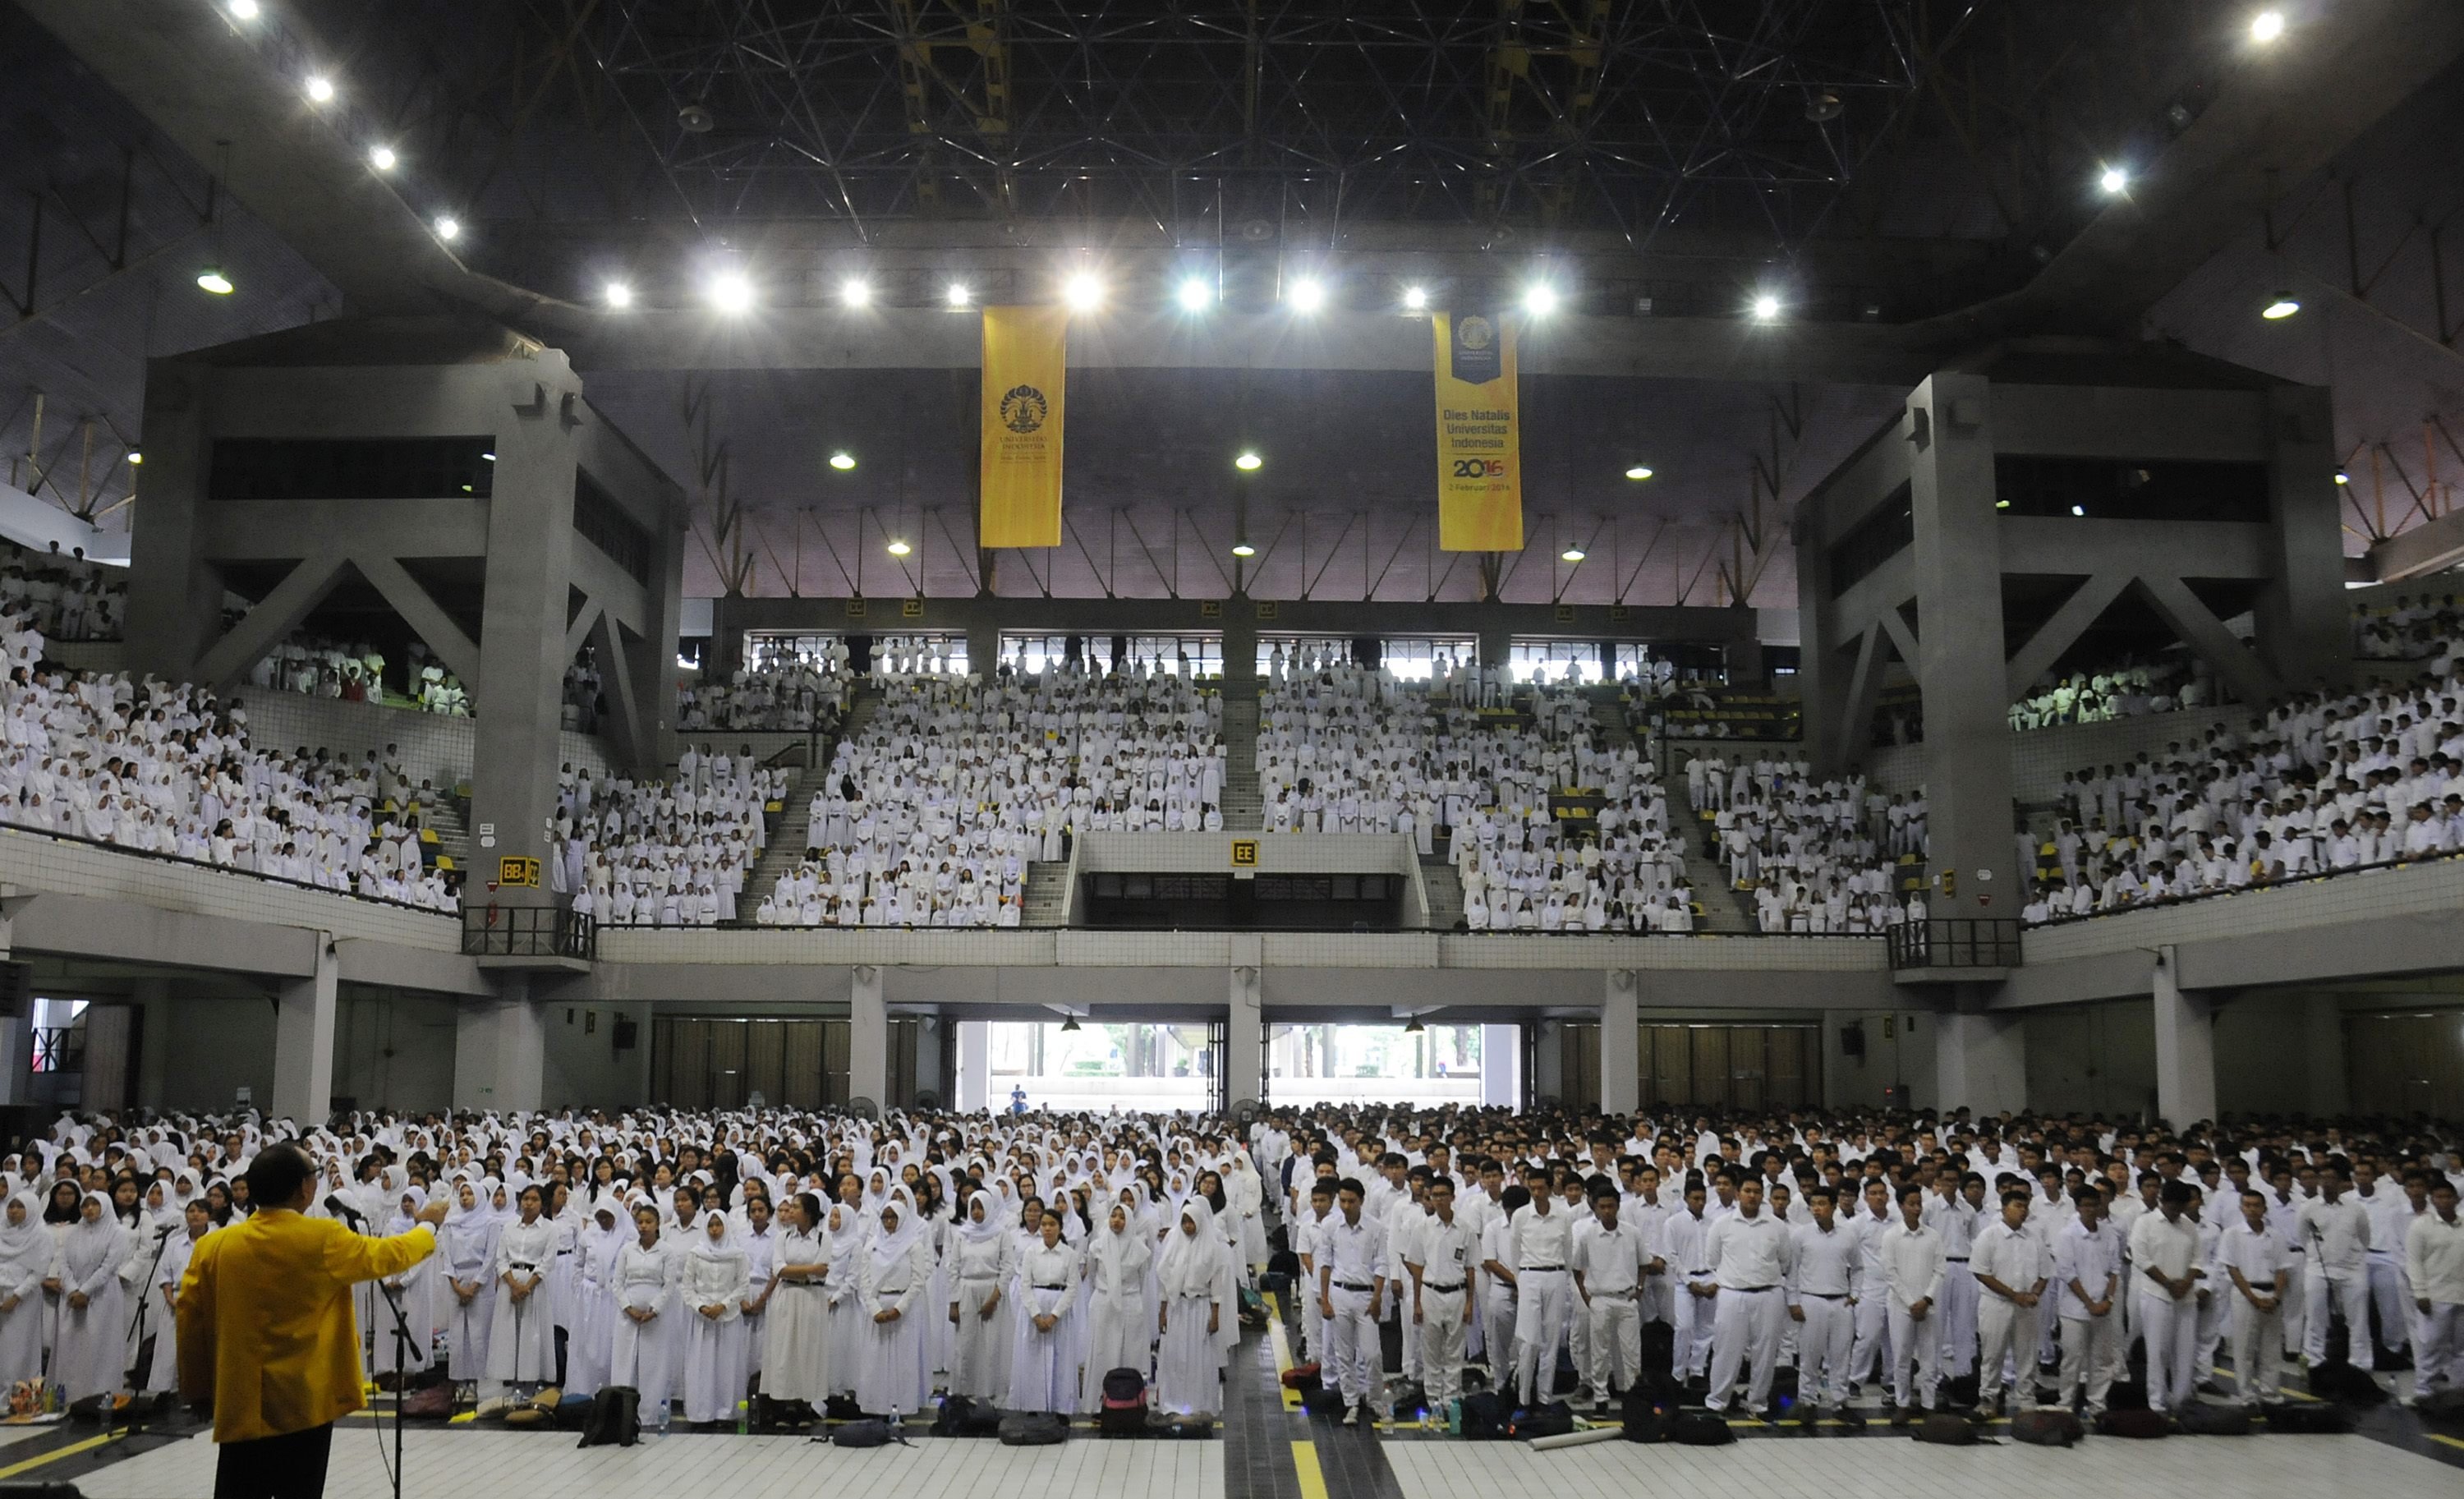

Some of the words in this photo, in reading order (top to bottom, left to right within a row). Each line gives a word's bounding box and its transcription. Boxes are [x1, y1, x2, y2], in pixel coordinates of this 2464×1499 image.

[1444, 409, 1468, 421] Dies
[1471, 409, 1510, 421] Natalis
[1447, 423, 1508, 435] Universitas
[1451, 437, 1504, 448] Indonesia
[1454, 458, 1504, 478] 2016
[1237, 846, 1253, 860] EE
